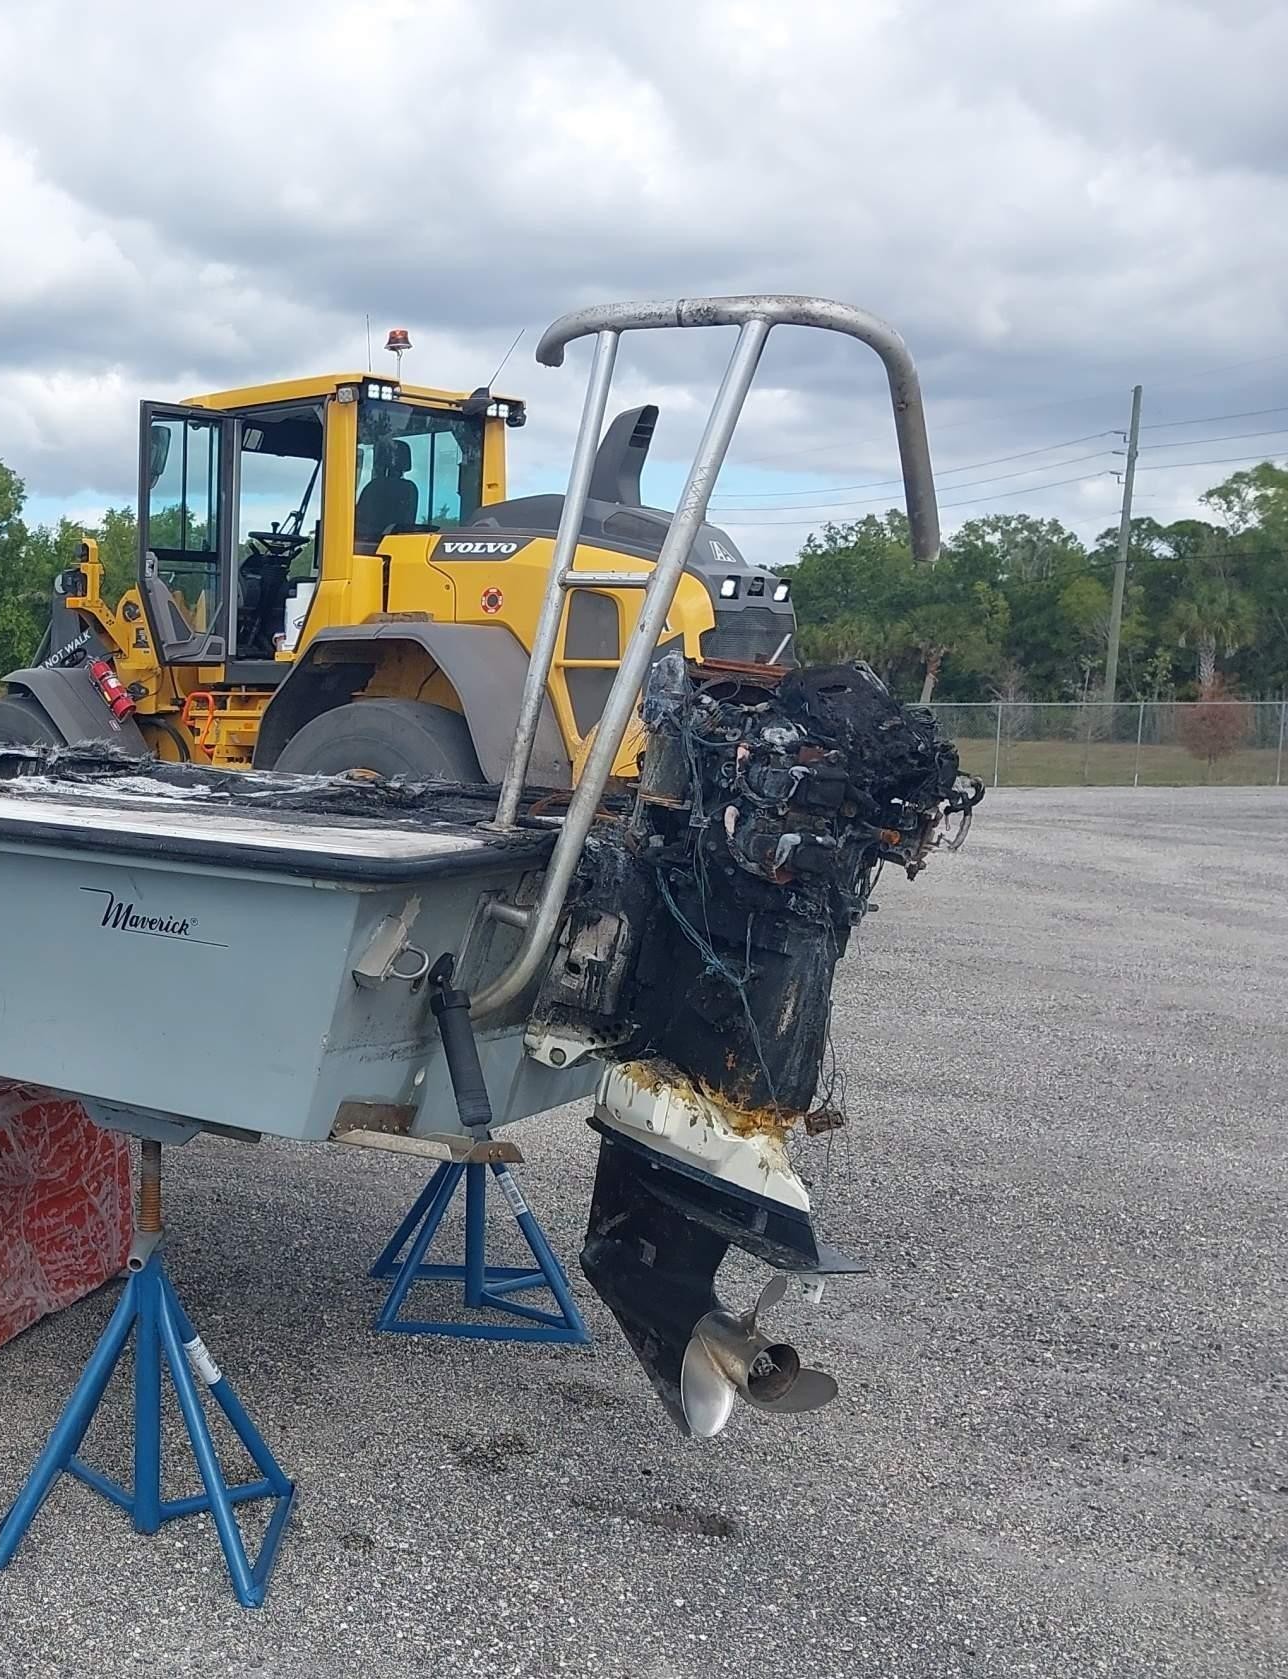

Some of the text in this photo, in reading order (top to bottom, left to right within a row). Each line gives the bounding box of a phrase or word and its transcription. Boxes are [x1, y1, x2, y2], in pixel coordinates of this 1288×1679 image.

[443, 542, 518, 554] VOLVO
[44, 630, 92, 669] NOT WALK
[101, 893, 192, 936] Maverick
